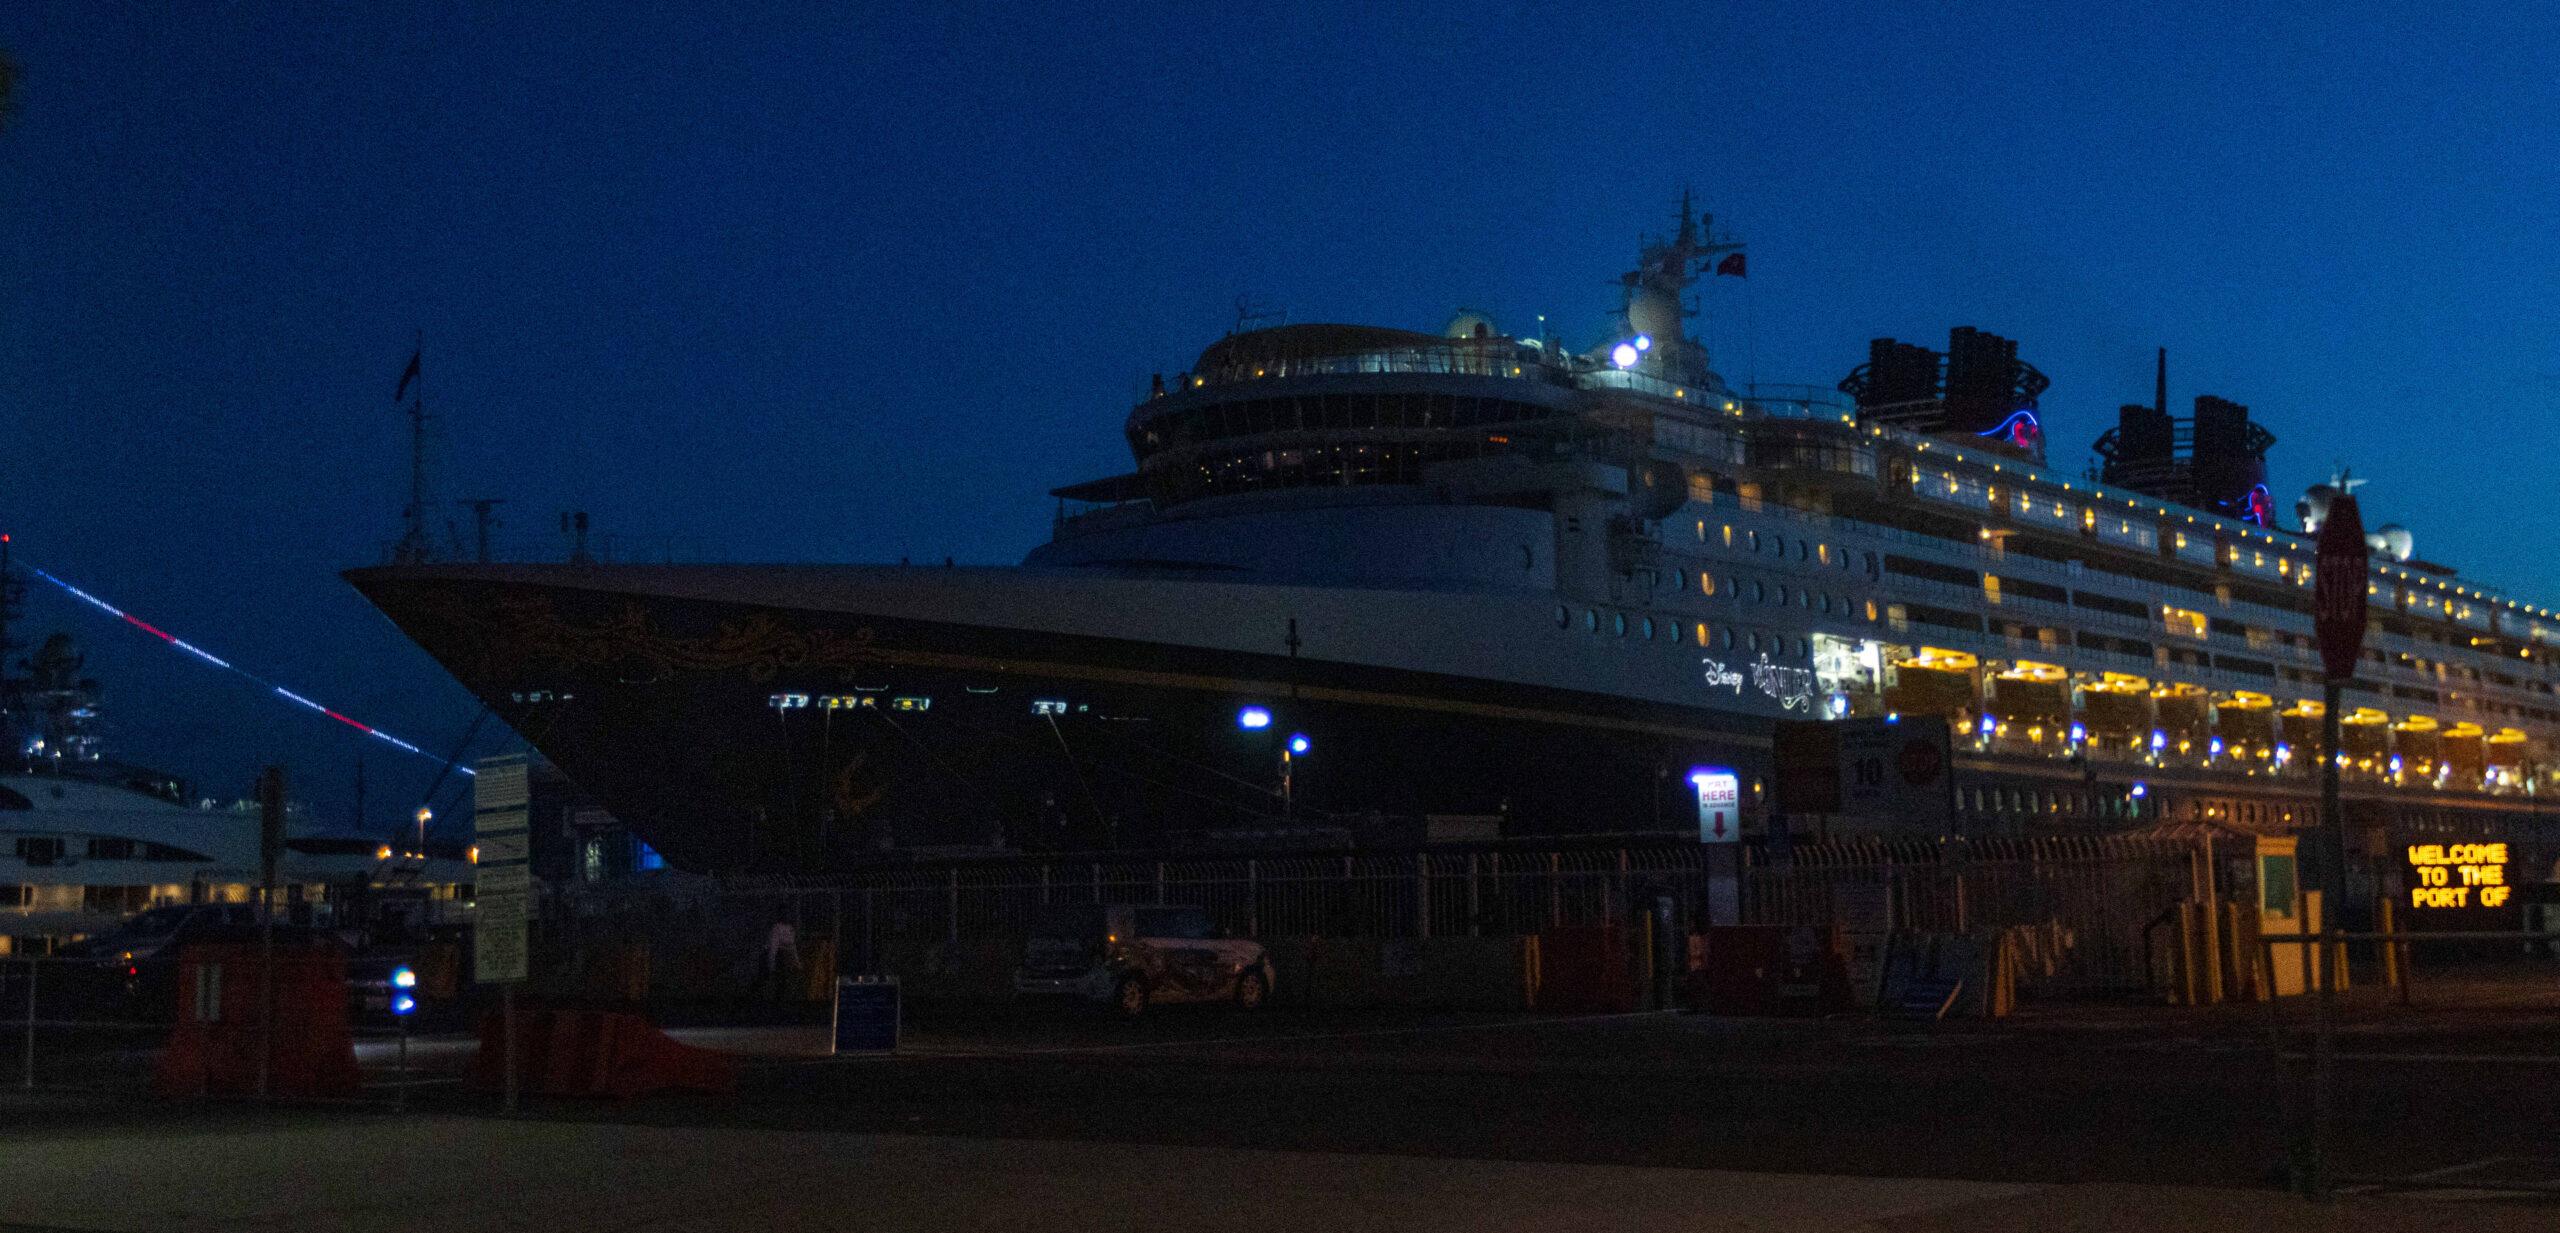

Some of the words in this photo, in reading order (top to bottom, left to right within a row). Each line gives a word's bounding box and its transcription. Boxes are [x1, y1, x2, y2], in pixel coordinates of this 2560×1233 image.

[1854, 757, 1882, 786] 10
[1703, 790, 1735, 800] HERE
[2408, 843, 2508, 865] WELCOME
[2417, 866, 2448, 887] TO
[2458, 865, 2503, 886] THE
[2412, 887, 2469, 908] PORT
[2480, 886, 2512, 907] OF
